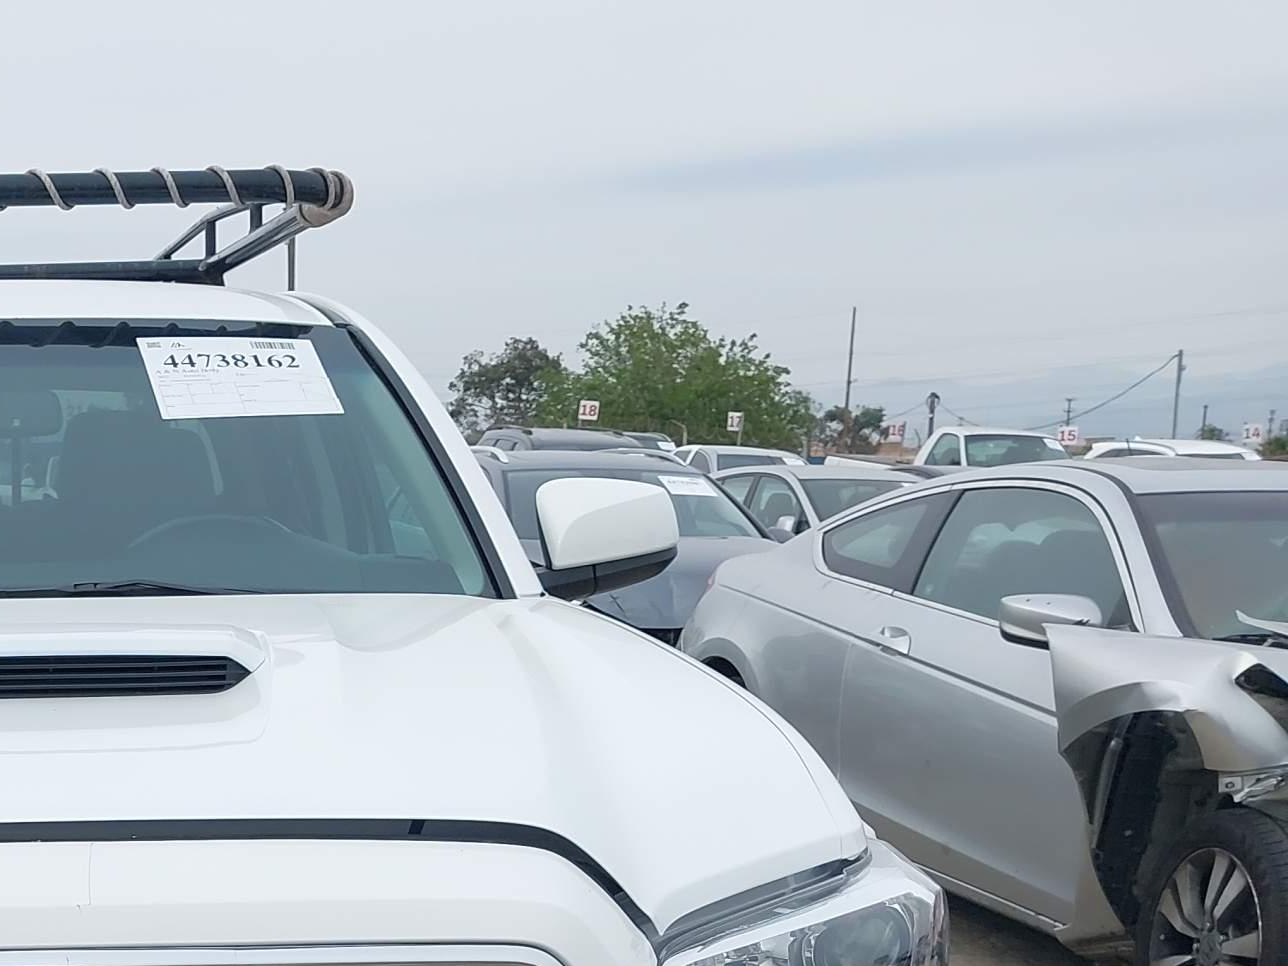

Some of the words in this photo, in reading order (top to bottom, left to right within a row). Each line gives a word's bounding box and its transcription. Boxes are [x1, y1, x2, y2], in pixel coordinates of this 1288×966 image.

[163, 353, 300, 368] 44738162
[580, 404, 597, 416] 18
[729, 416, 743, 428] 17
[1059, 430, 1076, 441] 15
